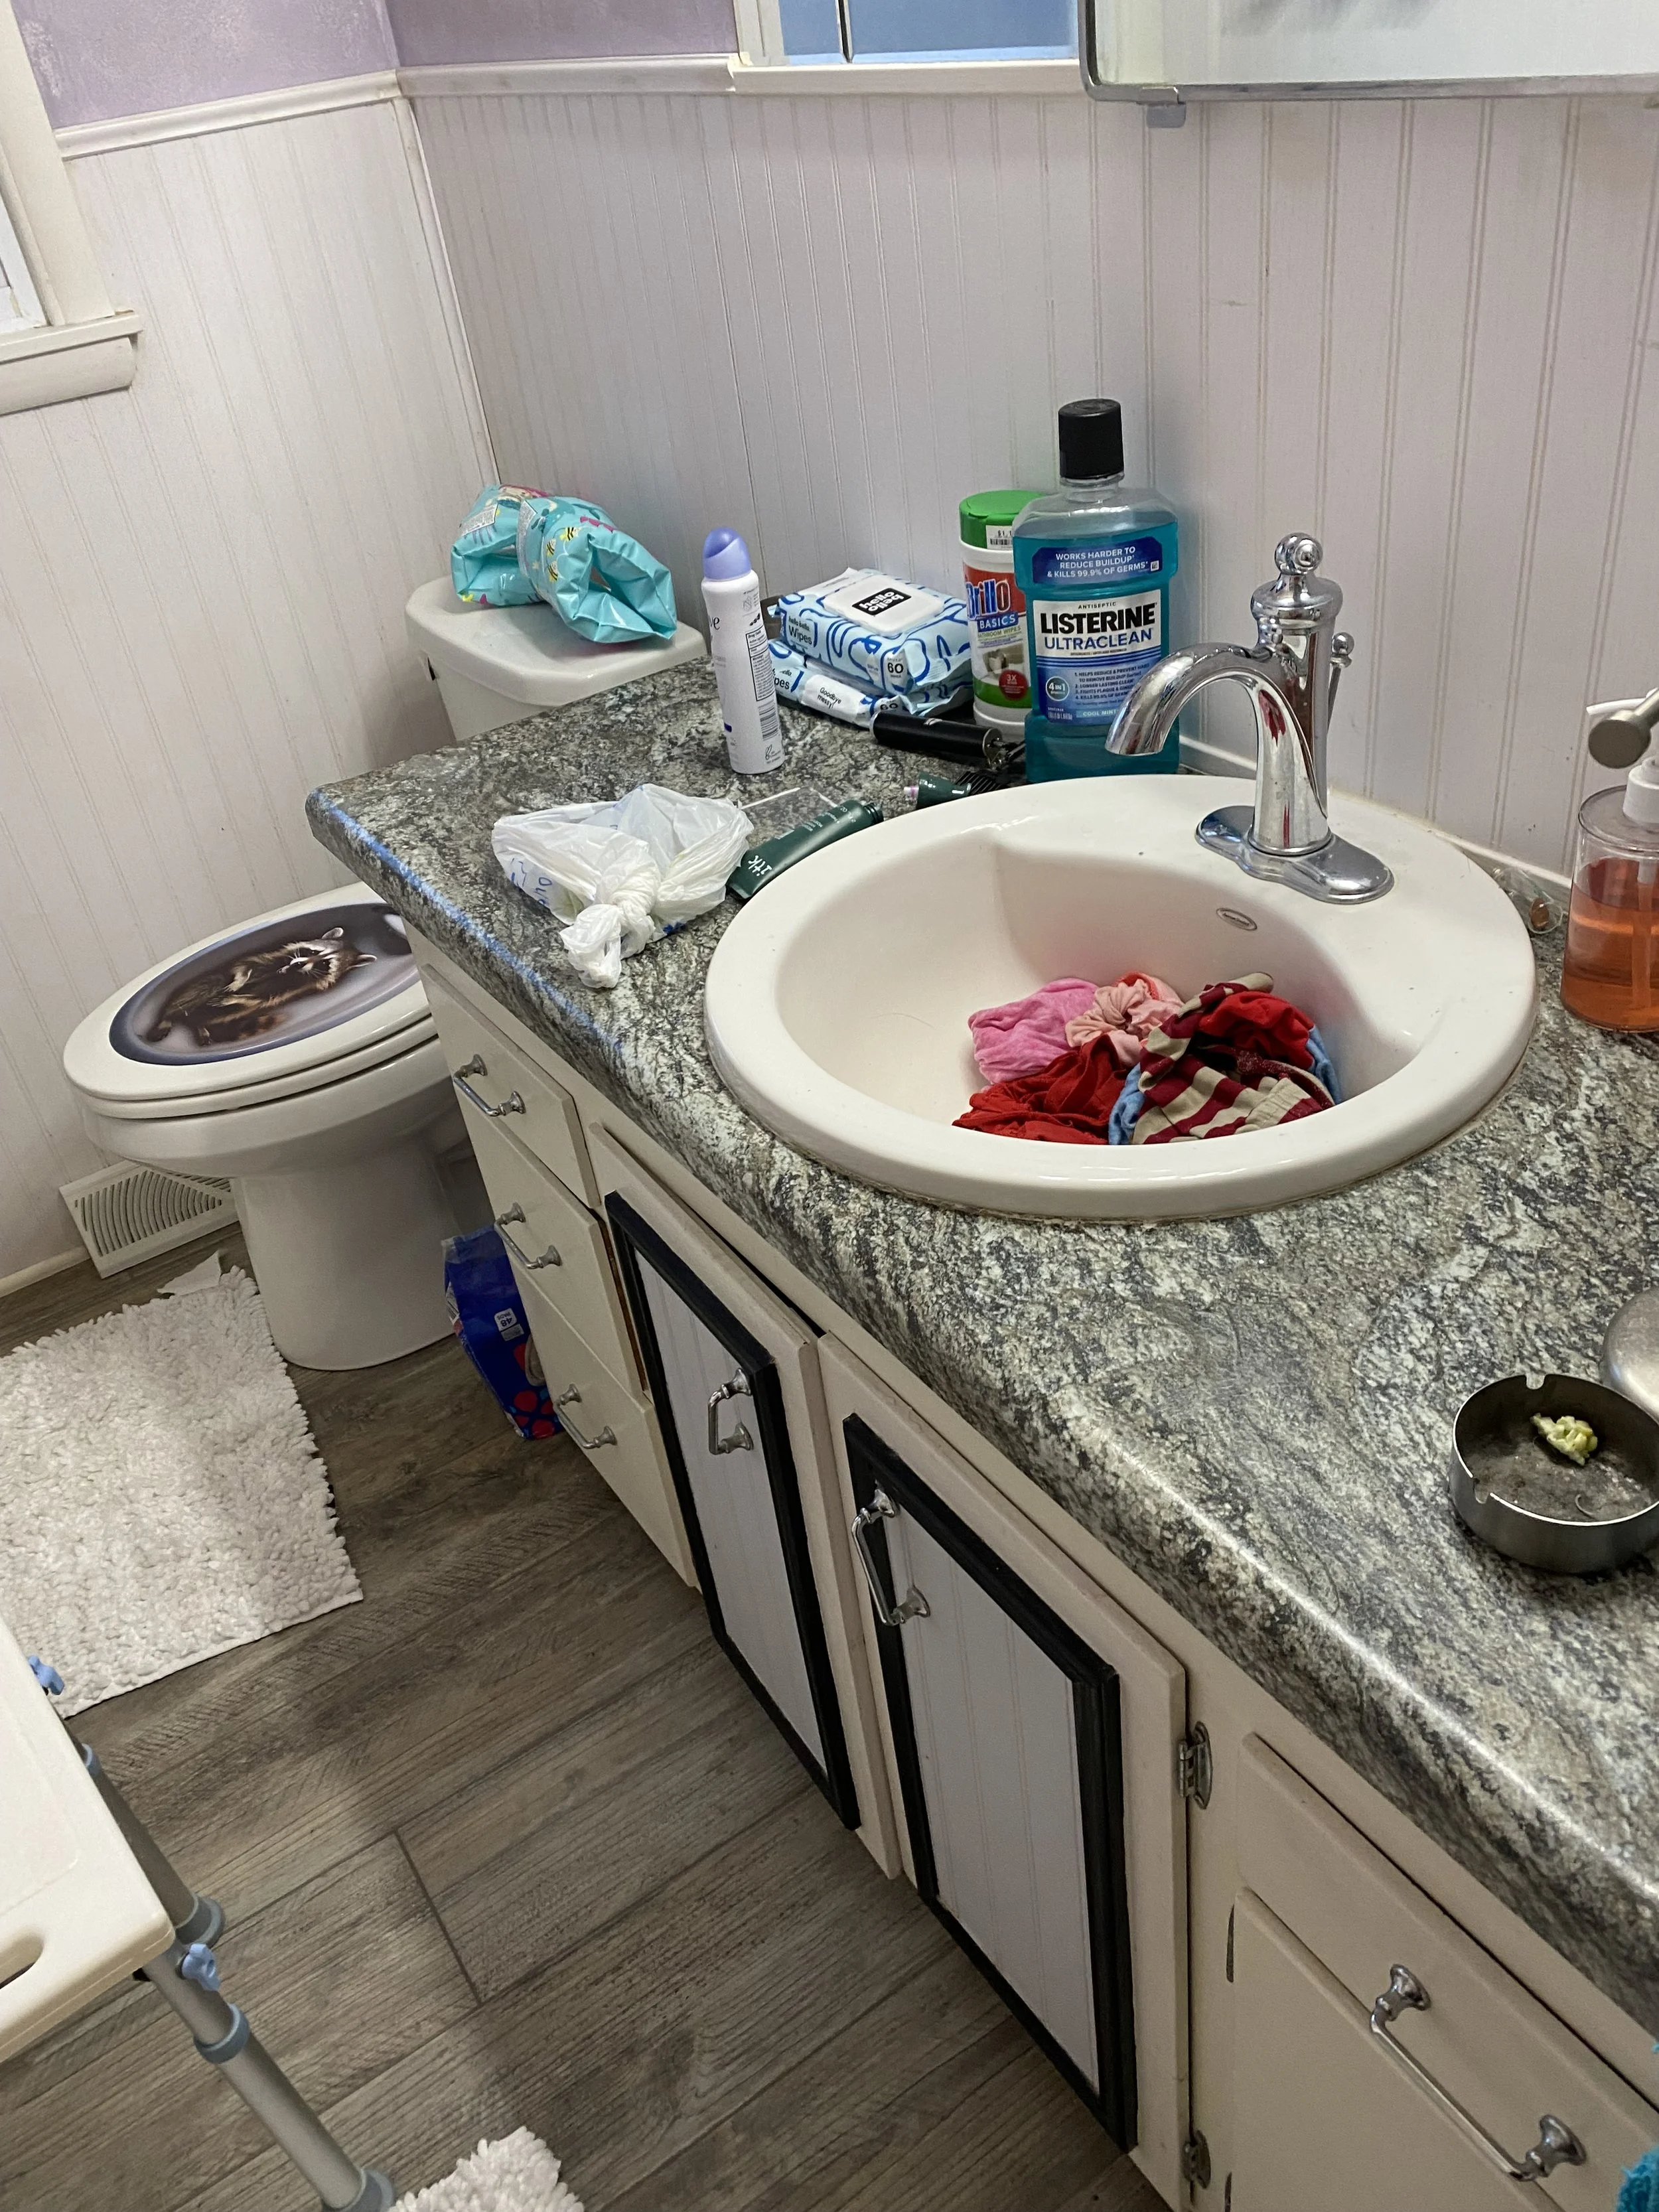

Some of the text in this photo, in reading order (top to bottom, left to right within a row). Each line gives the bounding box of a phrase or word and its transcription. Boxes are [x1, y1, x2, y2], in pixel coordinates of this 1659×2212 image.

[1056, 546, 1135, 561] WORKS HARDER TO
[1060, 561, 1094, 569] REDUCE
[1077, 568, 1102, 577] 99.9%
[1104, 567, 1116, 575] OF
[859, 591, 895, 609] hello
[966, 579, 1011, 620] Brillo
[979, 614, 1016, 629] BASICS
[1040, 603, 1156, 634] LISTERINE
[788, 625, 812, 645] Wipes
[1003, 625, 1021, 634] WIPES
[1045, 628, 1153, 650] ULTRACLEAN
[887, 662, 904, 674] 60
[774, 677, 790, 690] pes
[1048, 682, 1054, 691] 4
[818, 694, 833, 709] messy
[820, 687, 841, 709] Goodbye
[500, 1317, 512, 1327] 48
